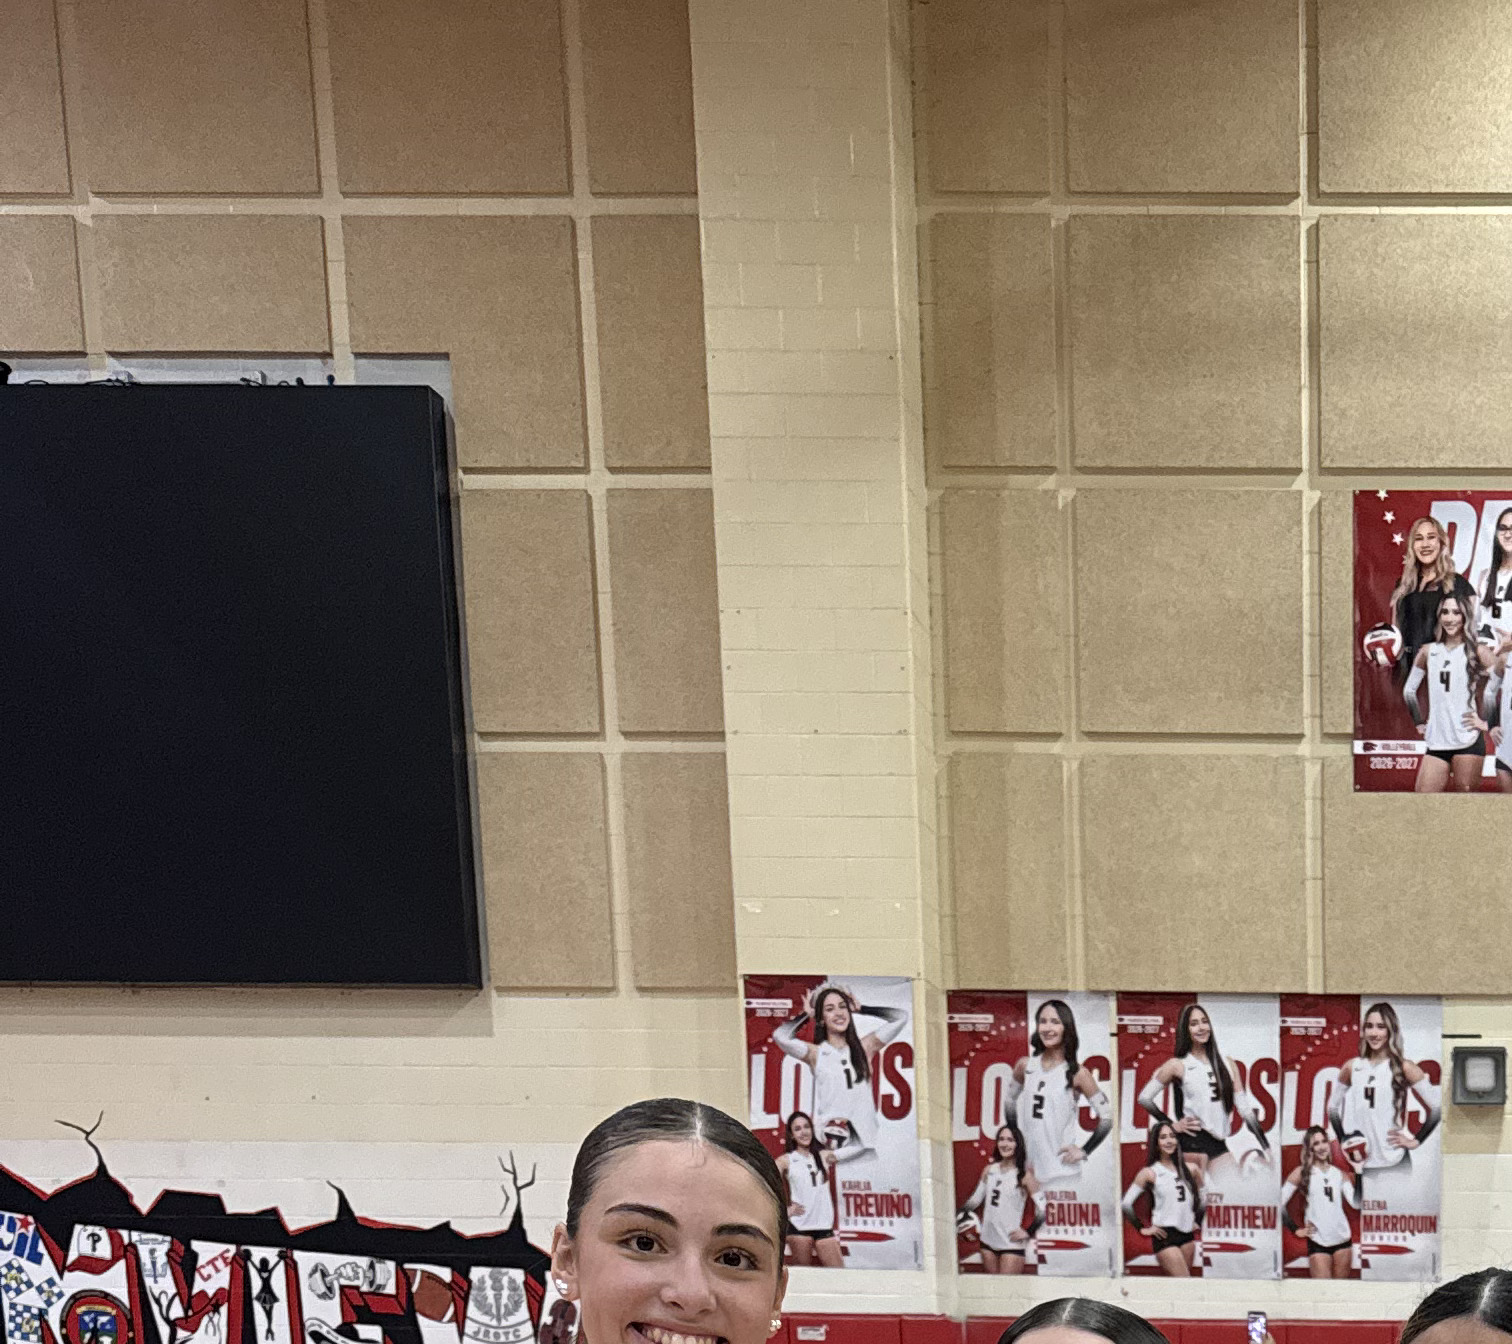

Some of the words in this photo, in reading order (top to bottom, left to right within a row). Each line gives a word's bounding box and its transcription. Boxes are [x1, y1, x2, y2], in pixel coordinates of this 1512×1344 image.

[1439, 671, 1450, 692] 4
[1032, 1094, 1045, 1119] 2
[1364, 1087, 1375, 1108] 4
[842, 1188, 913, 1219] TREVIÑO
[991, 1189, 1001, 1207] 2
[1175, 1185, 1186, 1202] 3
[1324, 1186, 1333, 1202] 4
[1045, 1202, 1101, 1227] GAUNA
[1206, 1205, 1277, 1229] MATHEW
[1363, 1214, 1437, 1236] MARROQUIN
[85, 1232, 102, 1253] P
[195, 1248, 232, 1282] CTE
